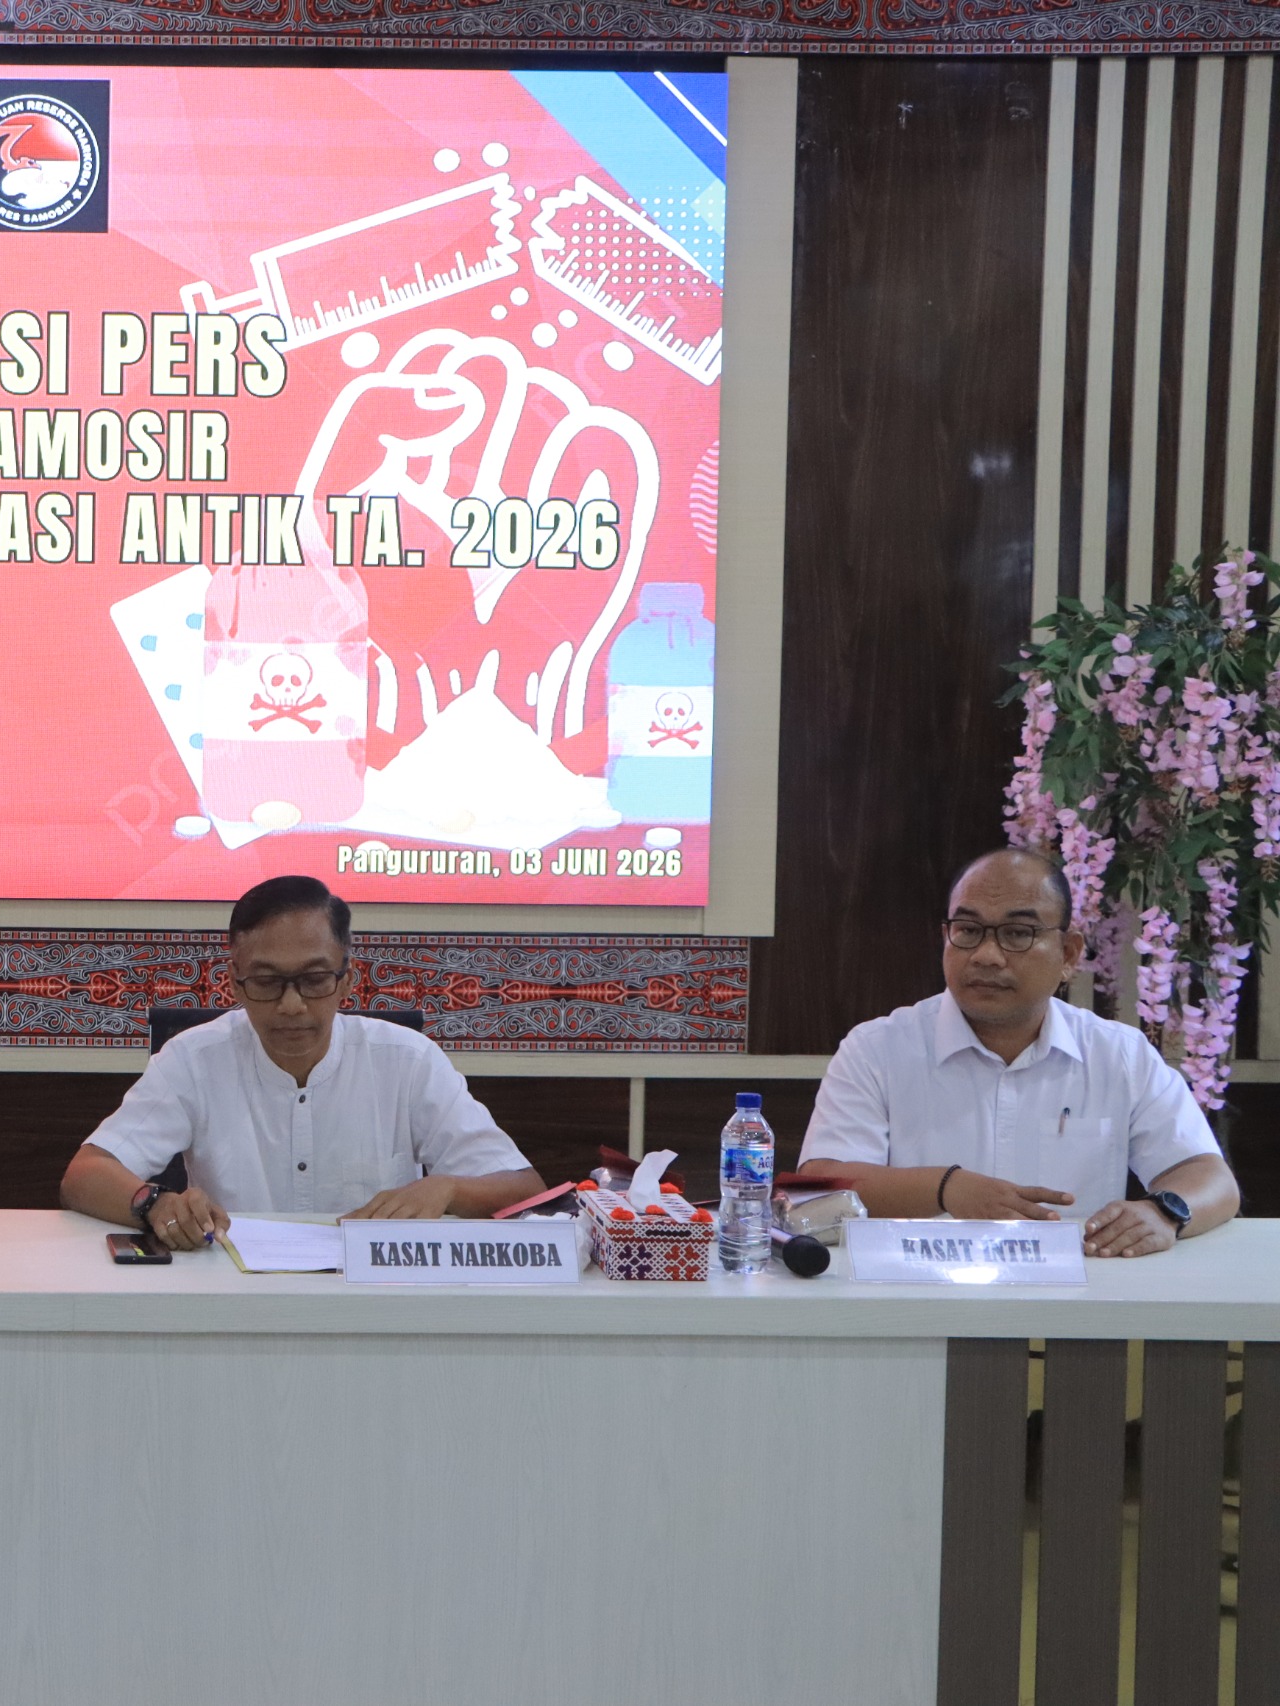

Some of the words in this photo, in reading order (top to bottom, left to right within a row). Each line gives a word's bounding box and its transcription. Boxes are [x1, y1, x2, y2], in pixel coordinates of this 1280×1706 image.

[27, 100, 79, 130] RESERSE
[74, 128, 92, 186] NARKOBA
[23, 200, 74, 223] SAMOSIR
[101, 311, 288, 398] PERS
[119, 493, 306, 566] ANTIK
[327, 495, 426, 567] TA.
[450, 497, 621, 571] 2026
[337, 845, 502, 878] Pangururan,
[509, 846, 543, 876] 03
[550, 847, 608, 877] JUNI
[616, 848, 683, 877] 2026
[370, 1241, 442, 1267] KASAT
[449, 1242, 563, 1267] NARKOBA
[901, 1238, 974, 1262] KASAT
[980, 1238, 1047, 1263] INTEL
